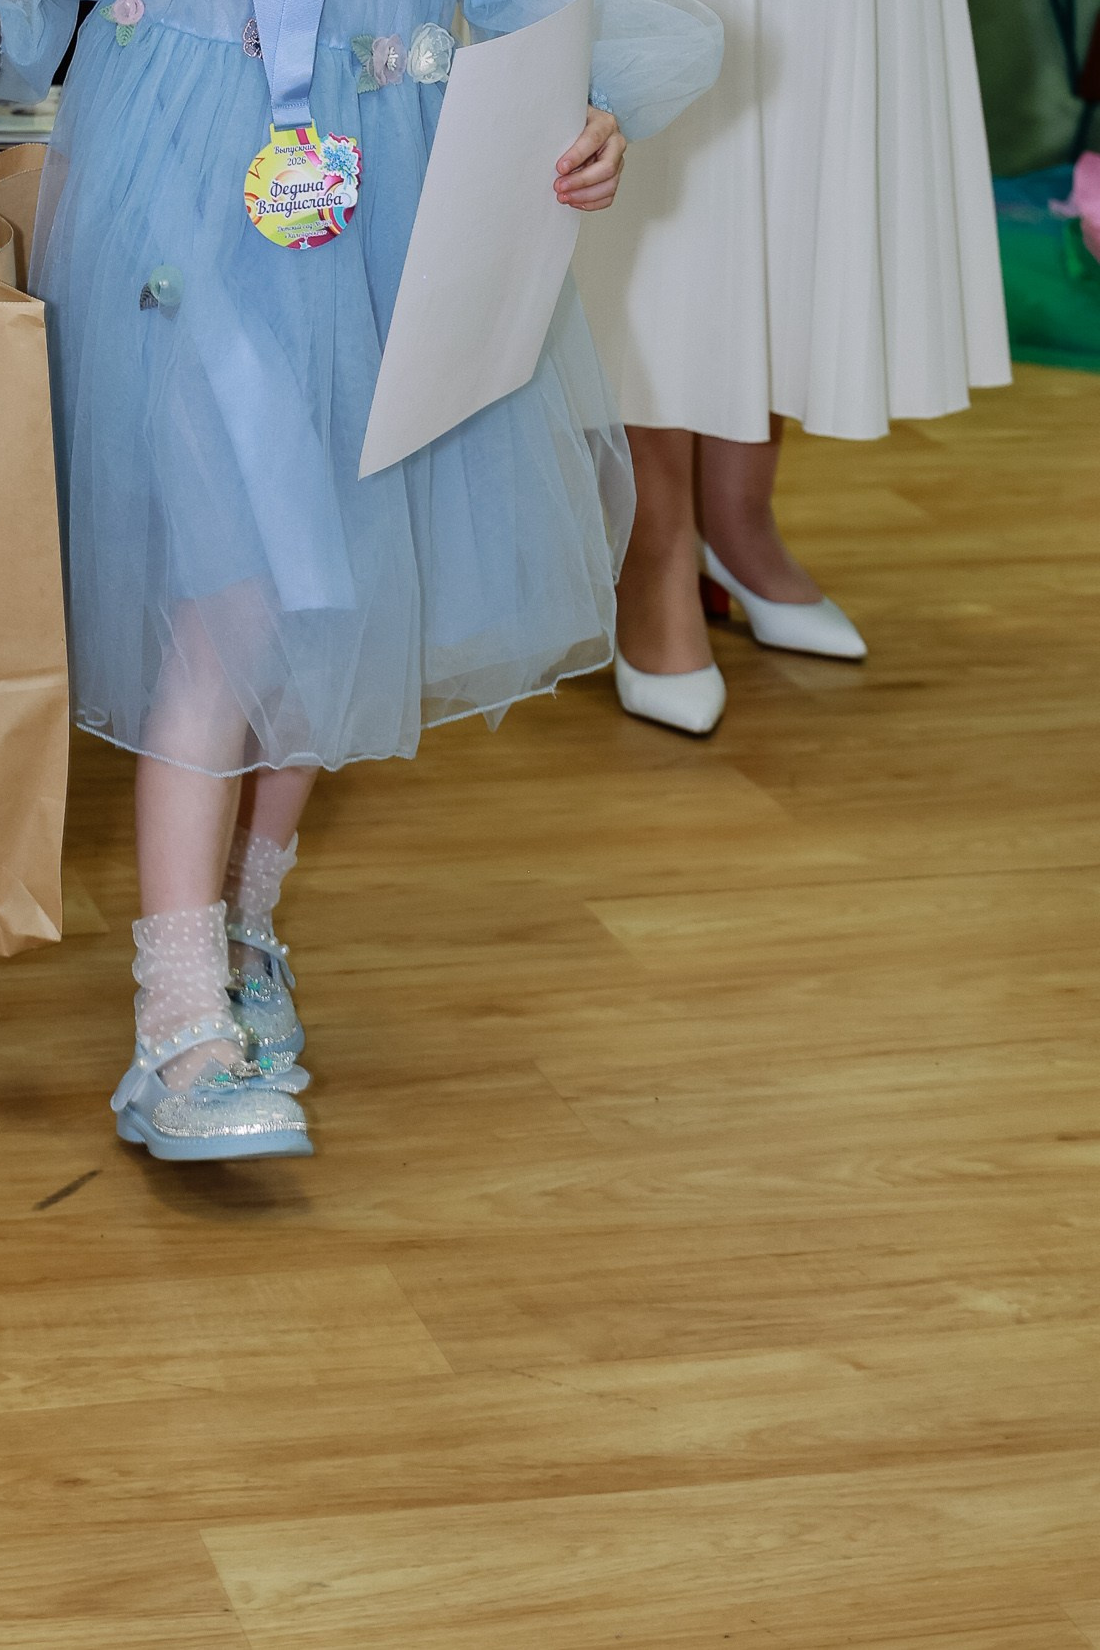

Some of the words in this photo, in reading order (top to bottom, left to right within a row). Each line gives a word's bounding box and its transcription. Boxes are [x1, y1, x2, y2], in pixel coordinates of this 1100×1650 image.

[274, 144, 317, 156] Выпускник
[287, 158, 307, 166] 2026
[270, 180, 324, 200] Федина
[256, 193, 343, 218] Владислава
